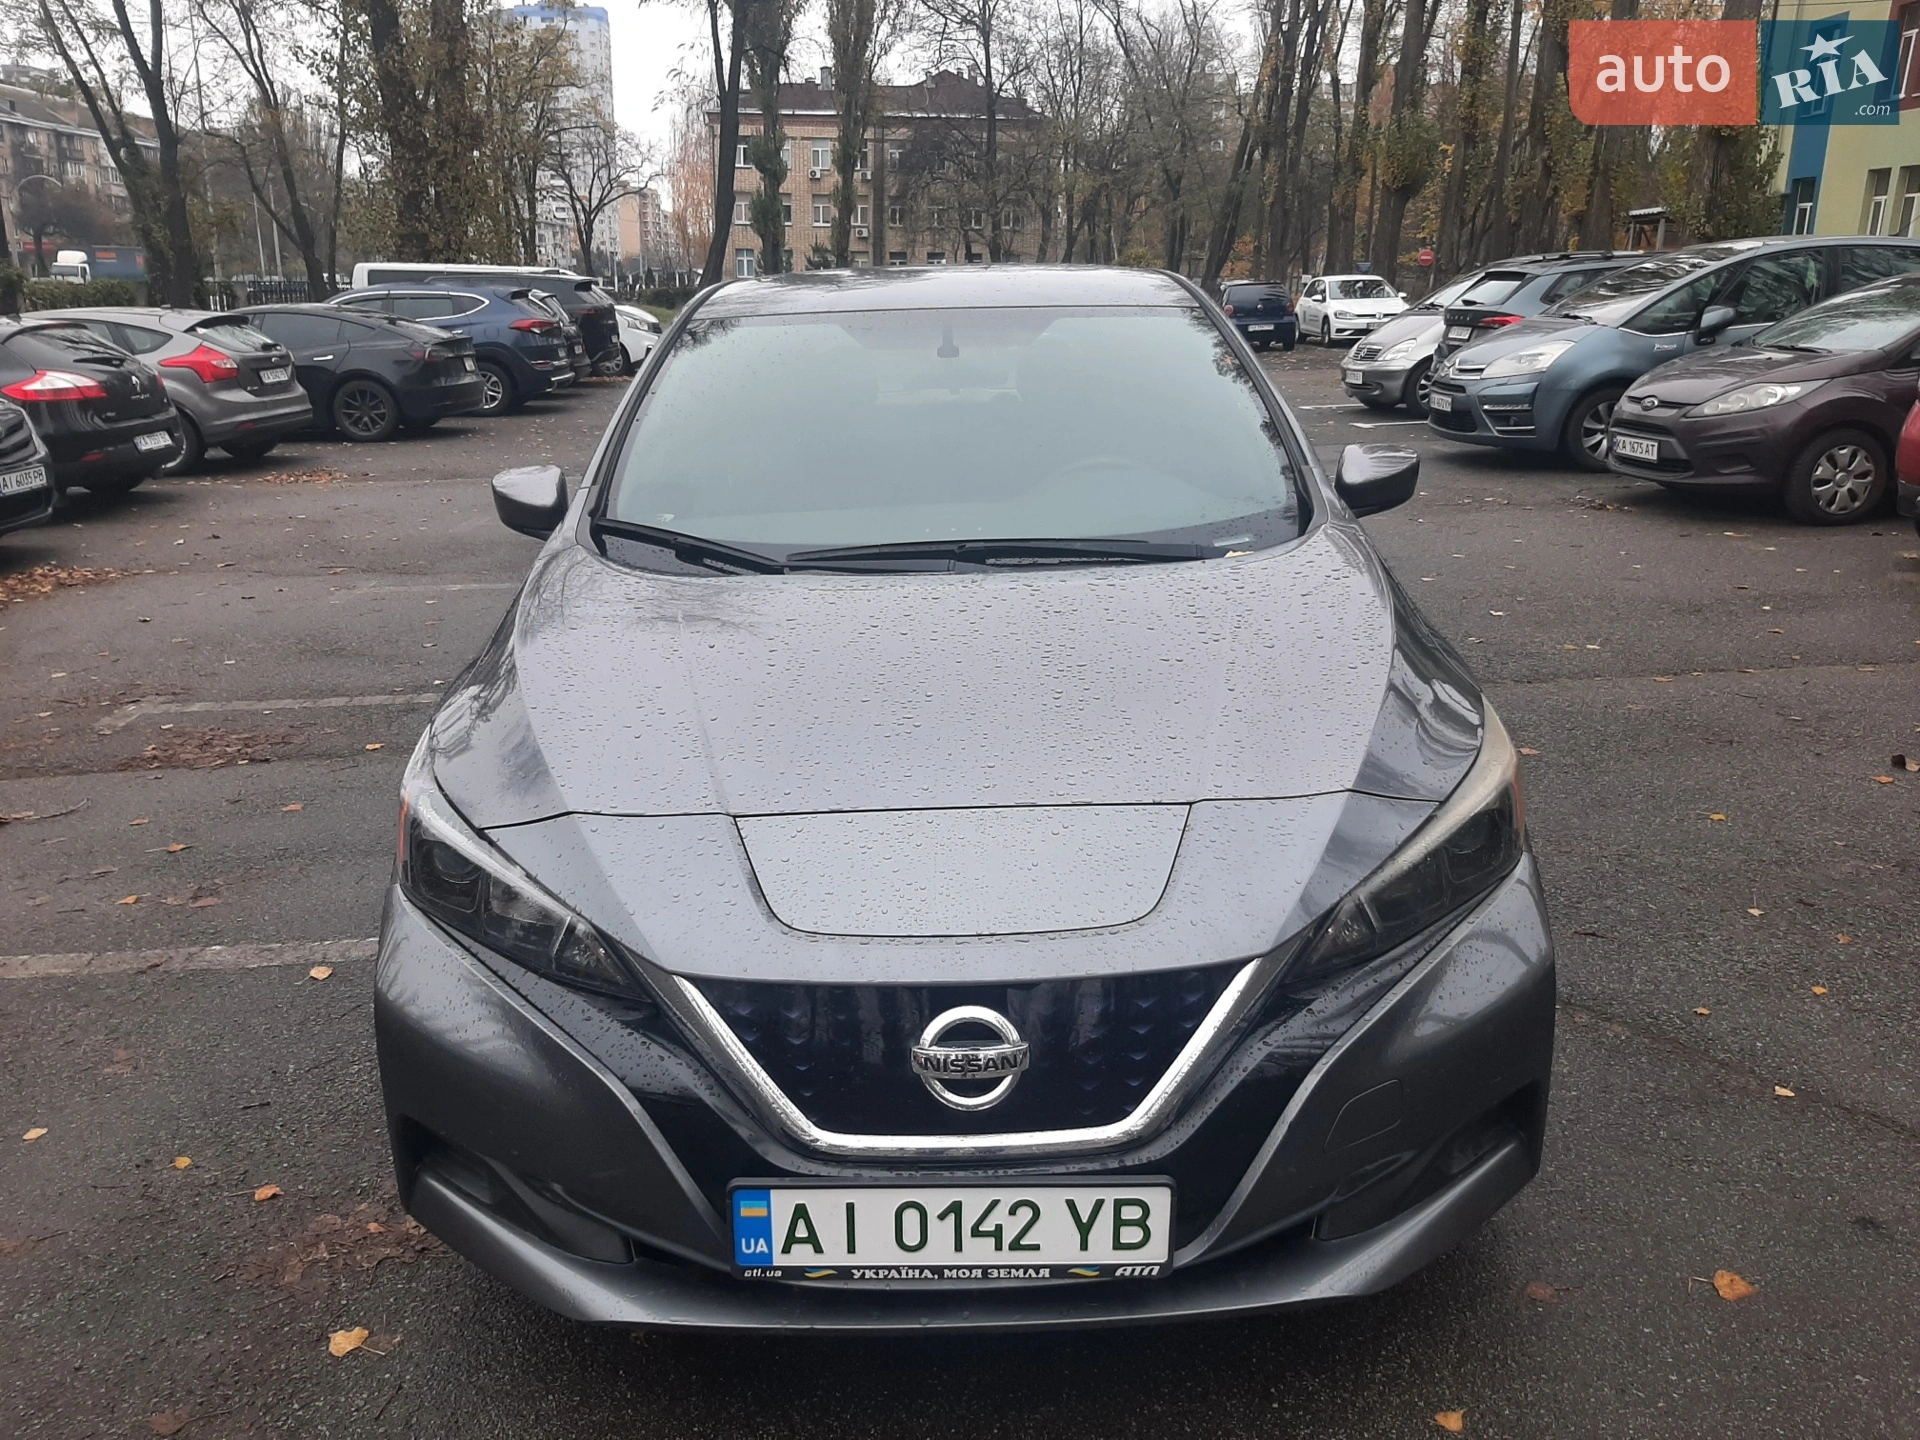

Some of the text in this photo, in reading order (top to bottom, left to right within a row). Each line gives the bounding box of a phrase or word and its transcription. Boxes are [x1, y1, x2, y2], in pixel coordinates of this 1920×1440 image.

[1615, 438, 1627, 452] KA
[1644, 443, 1656, 457] AT
[2, 476, 14, 491] AI
[920, 1053, 1019, 1074] NISSAN
[780, 1197, 1152, 1255] AI 0142 YB
[740, 1238, 770, 1255] UA
[850, 1266, 1051, 1280] УКРАЇНА, МОЯ ЗЕМЛЯ
